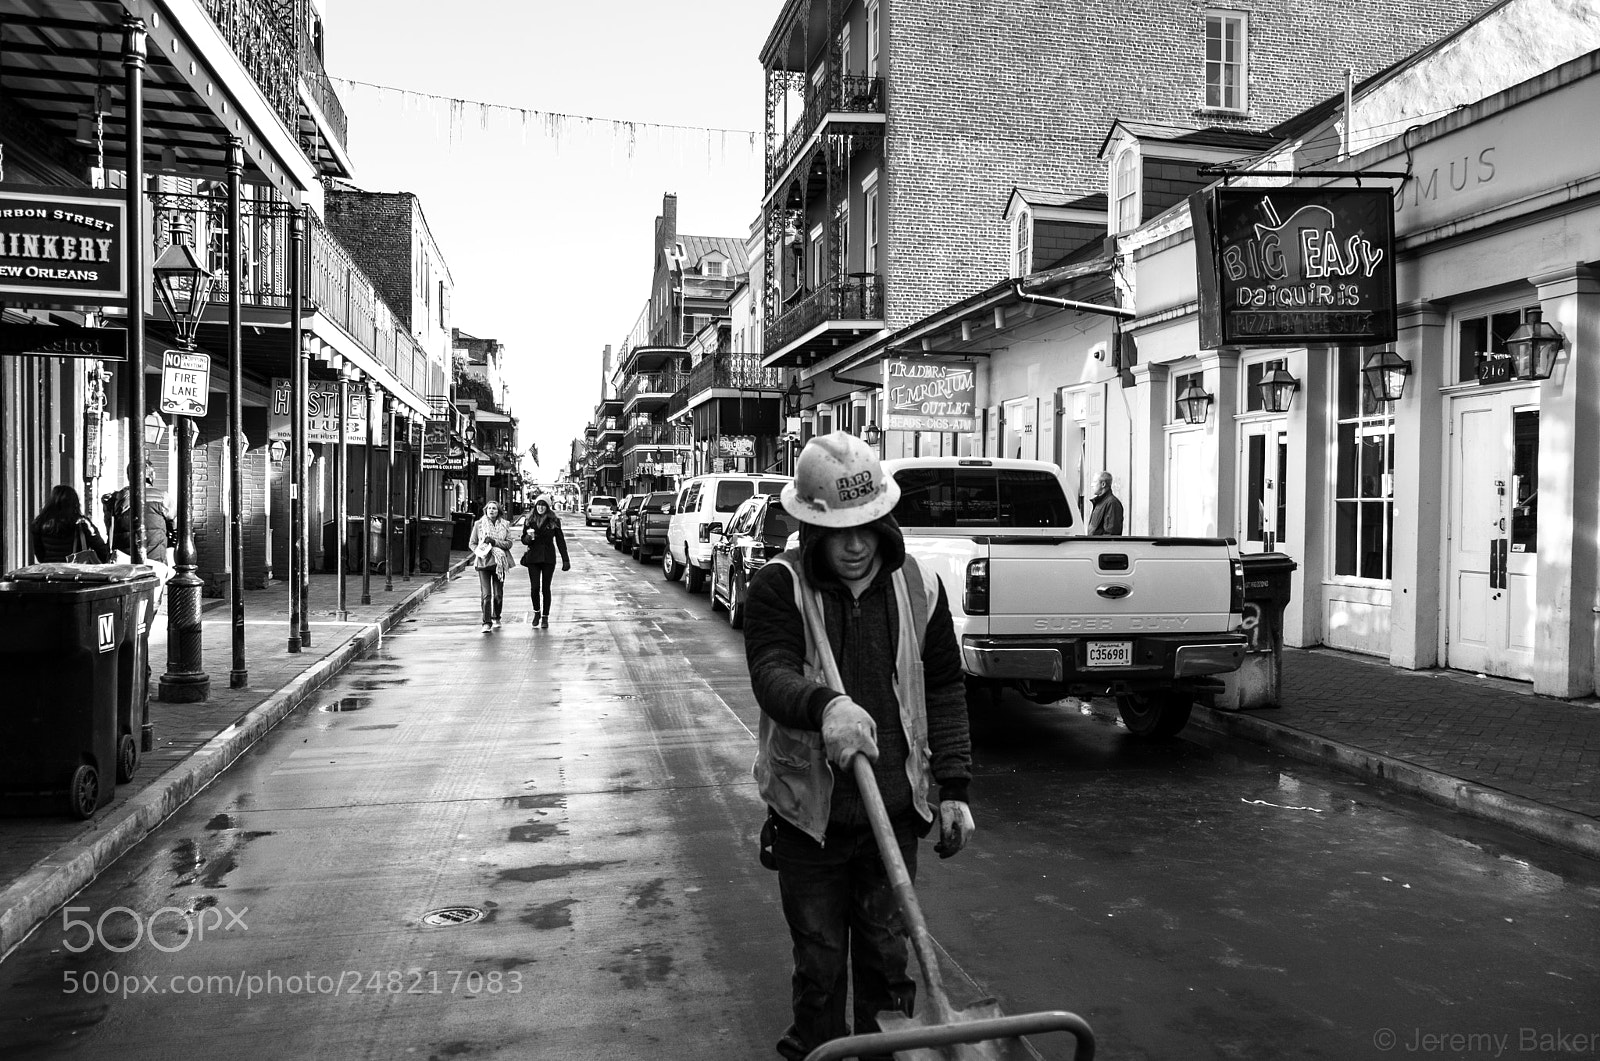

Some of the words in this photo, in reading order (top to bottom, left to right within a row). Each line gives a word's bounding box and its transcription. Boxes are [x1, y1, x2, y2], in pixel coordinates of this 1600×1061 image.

[0, 209, 47, 218] RBON
[53, 210, 114, 231] STREET
[1223, 234, 1288, 281] BIG
[1302, 229, 1384, 278] EASY
[25, 266, 98, 281] ORLEANS
[1236, 314, 1274, 333] PIZZA
[166, 353, 181, 367] NO
[889, 361, 947, 378] TRADERS
[174, 373, 197, 384] FIRE
[171, 385, 198, 398] LANE
[890, 372, 974, 405] EMPORIUM
[921, 402, 971, 415] OUTLET
[836, 470, 871, 490] HARD
[840, 481, 875, 501] ROCK
[1033, 617, 1113, 631] SUPER
[1129, 616, 1189, 630] DUTY
[1090, 648, 1128, 660] C356981
